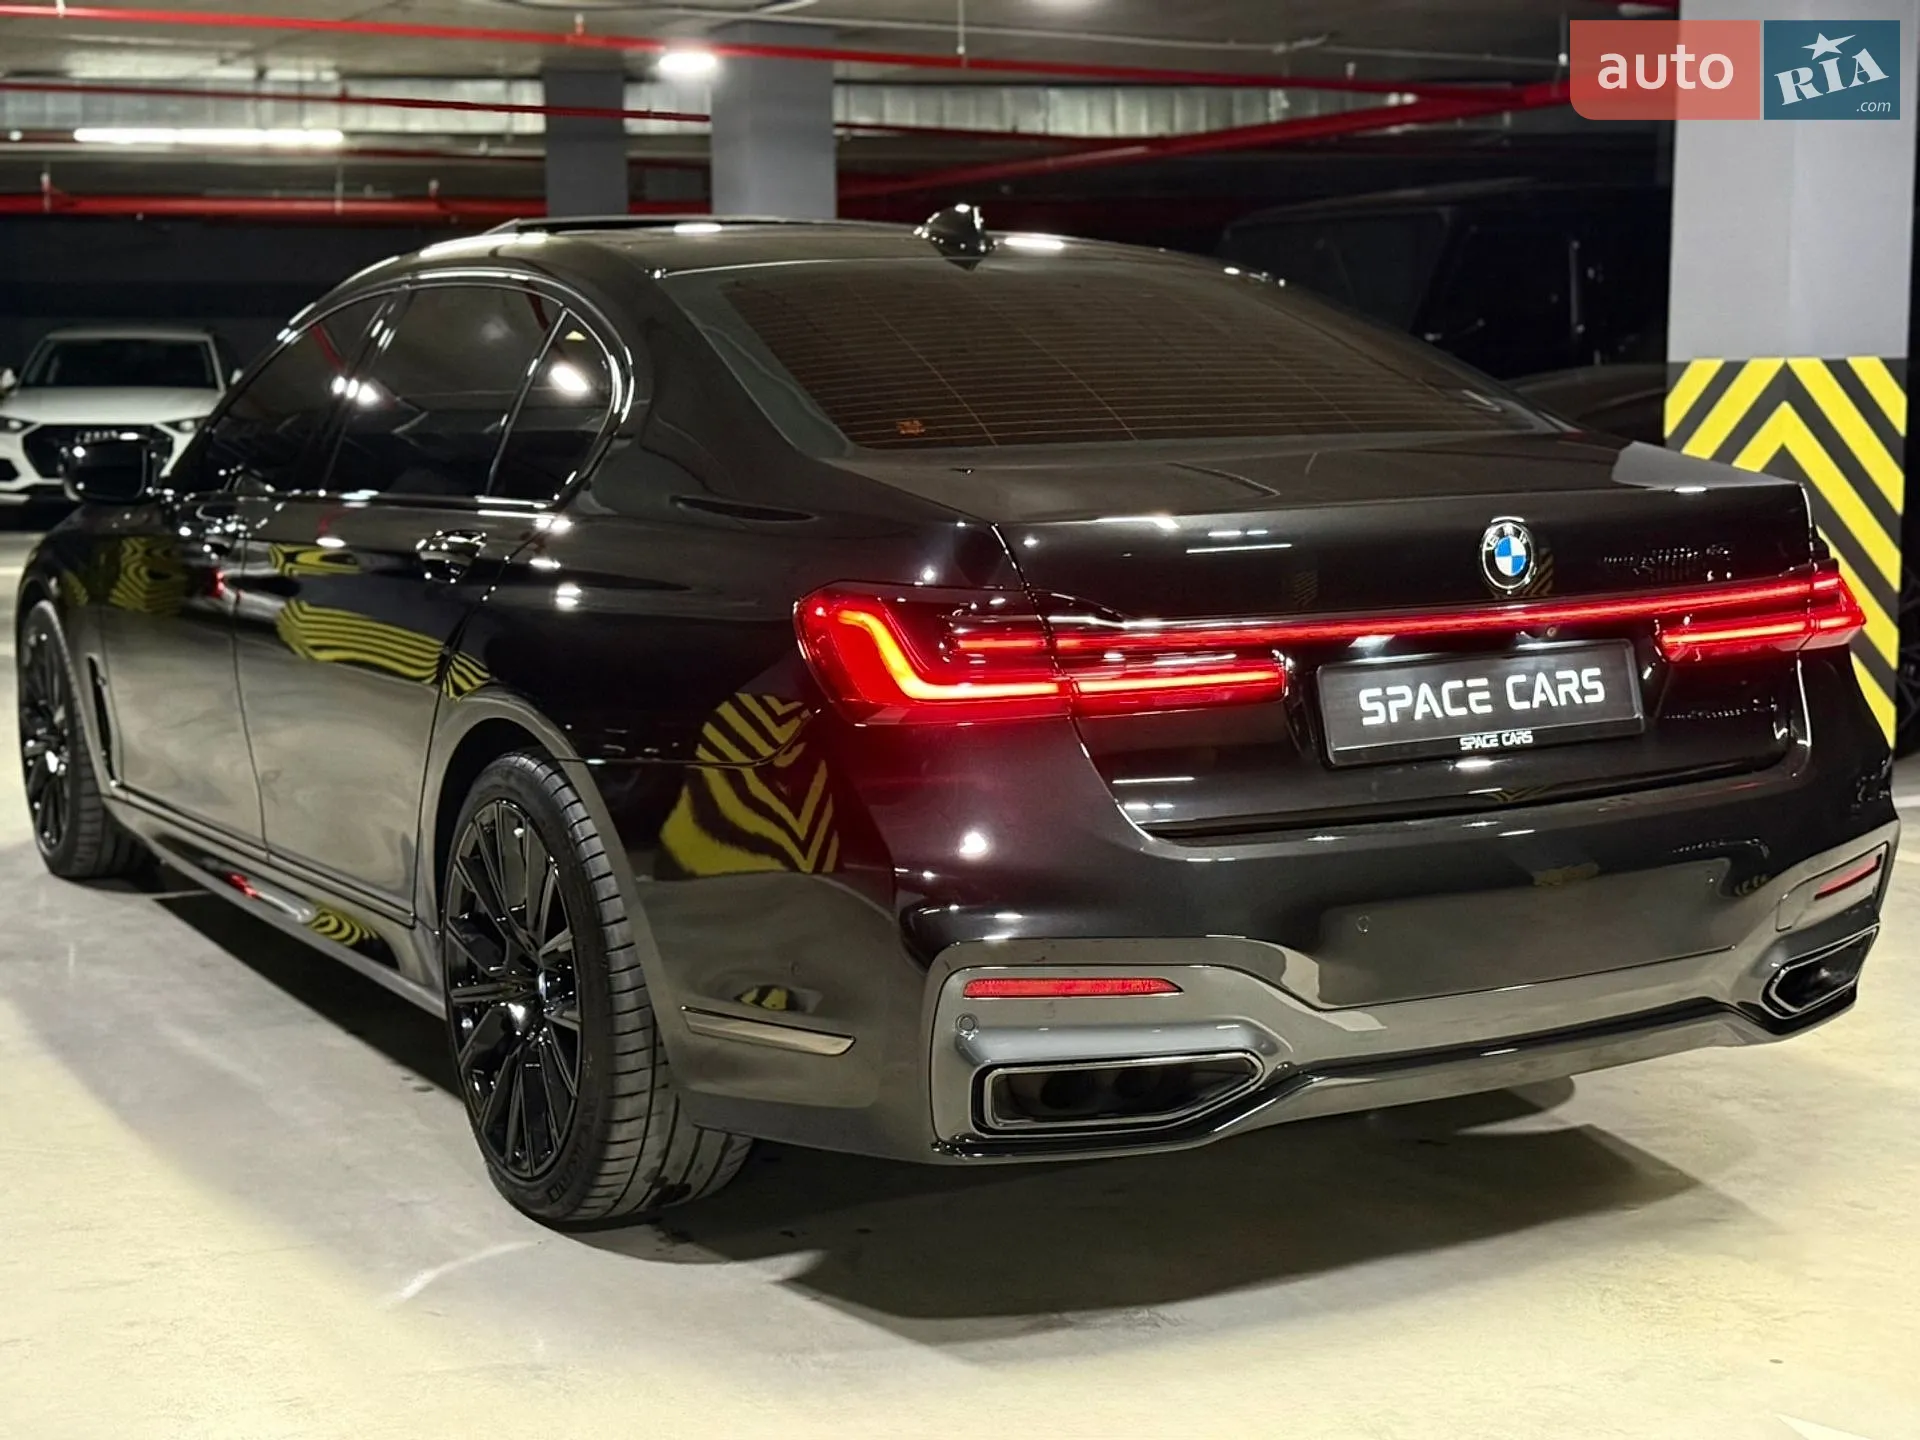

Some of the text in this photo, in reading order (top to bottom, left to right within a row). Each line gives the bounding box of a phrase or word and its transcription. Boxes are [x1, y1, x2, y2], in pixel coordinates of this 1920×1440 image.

[1359, 667, 1606, 726] SPACE CARS
[1459, 730, 1533, 750] SPACE CARS
